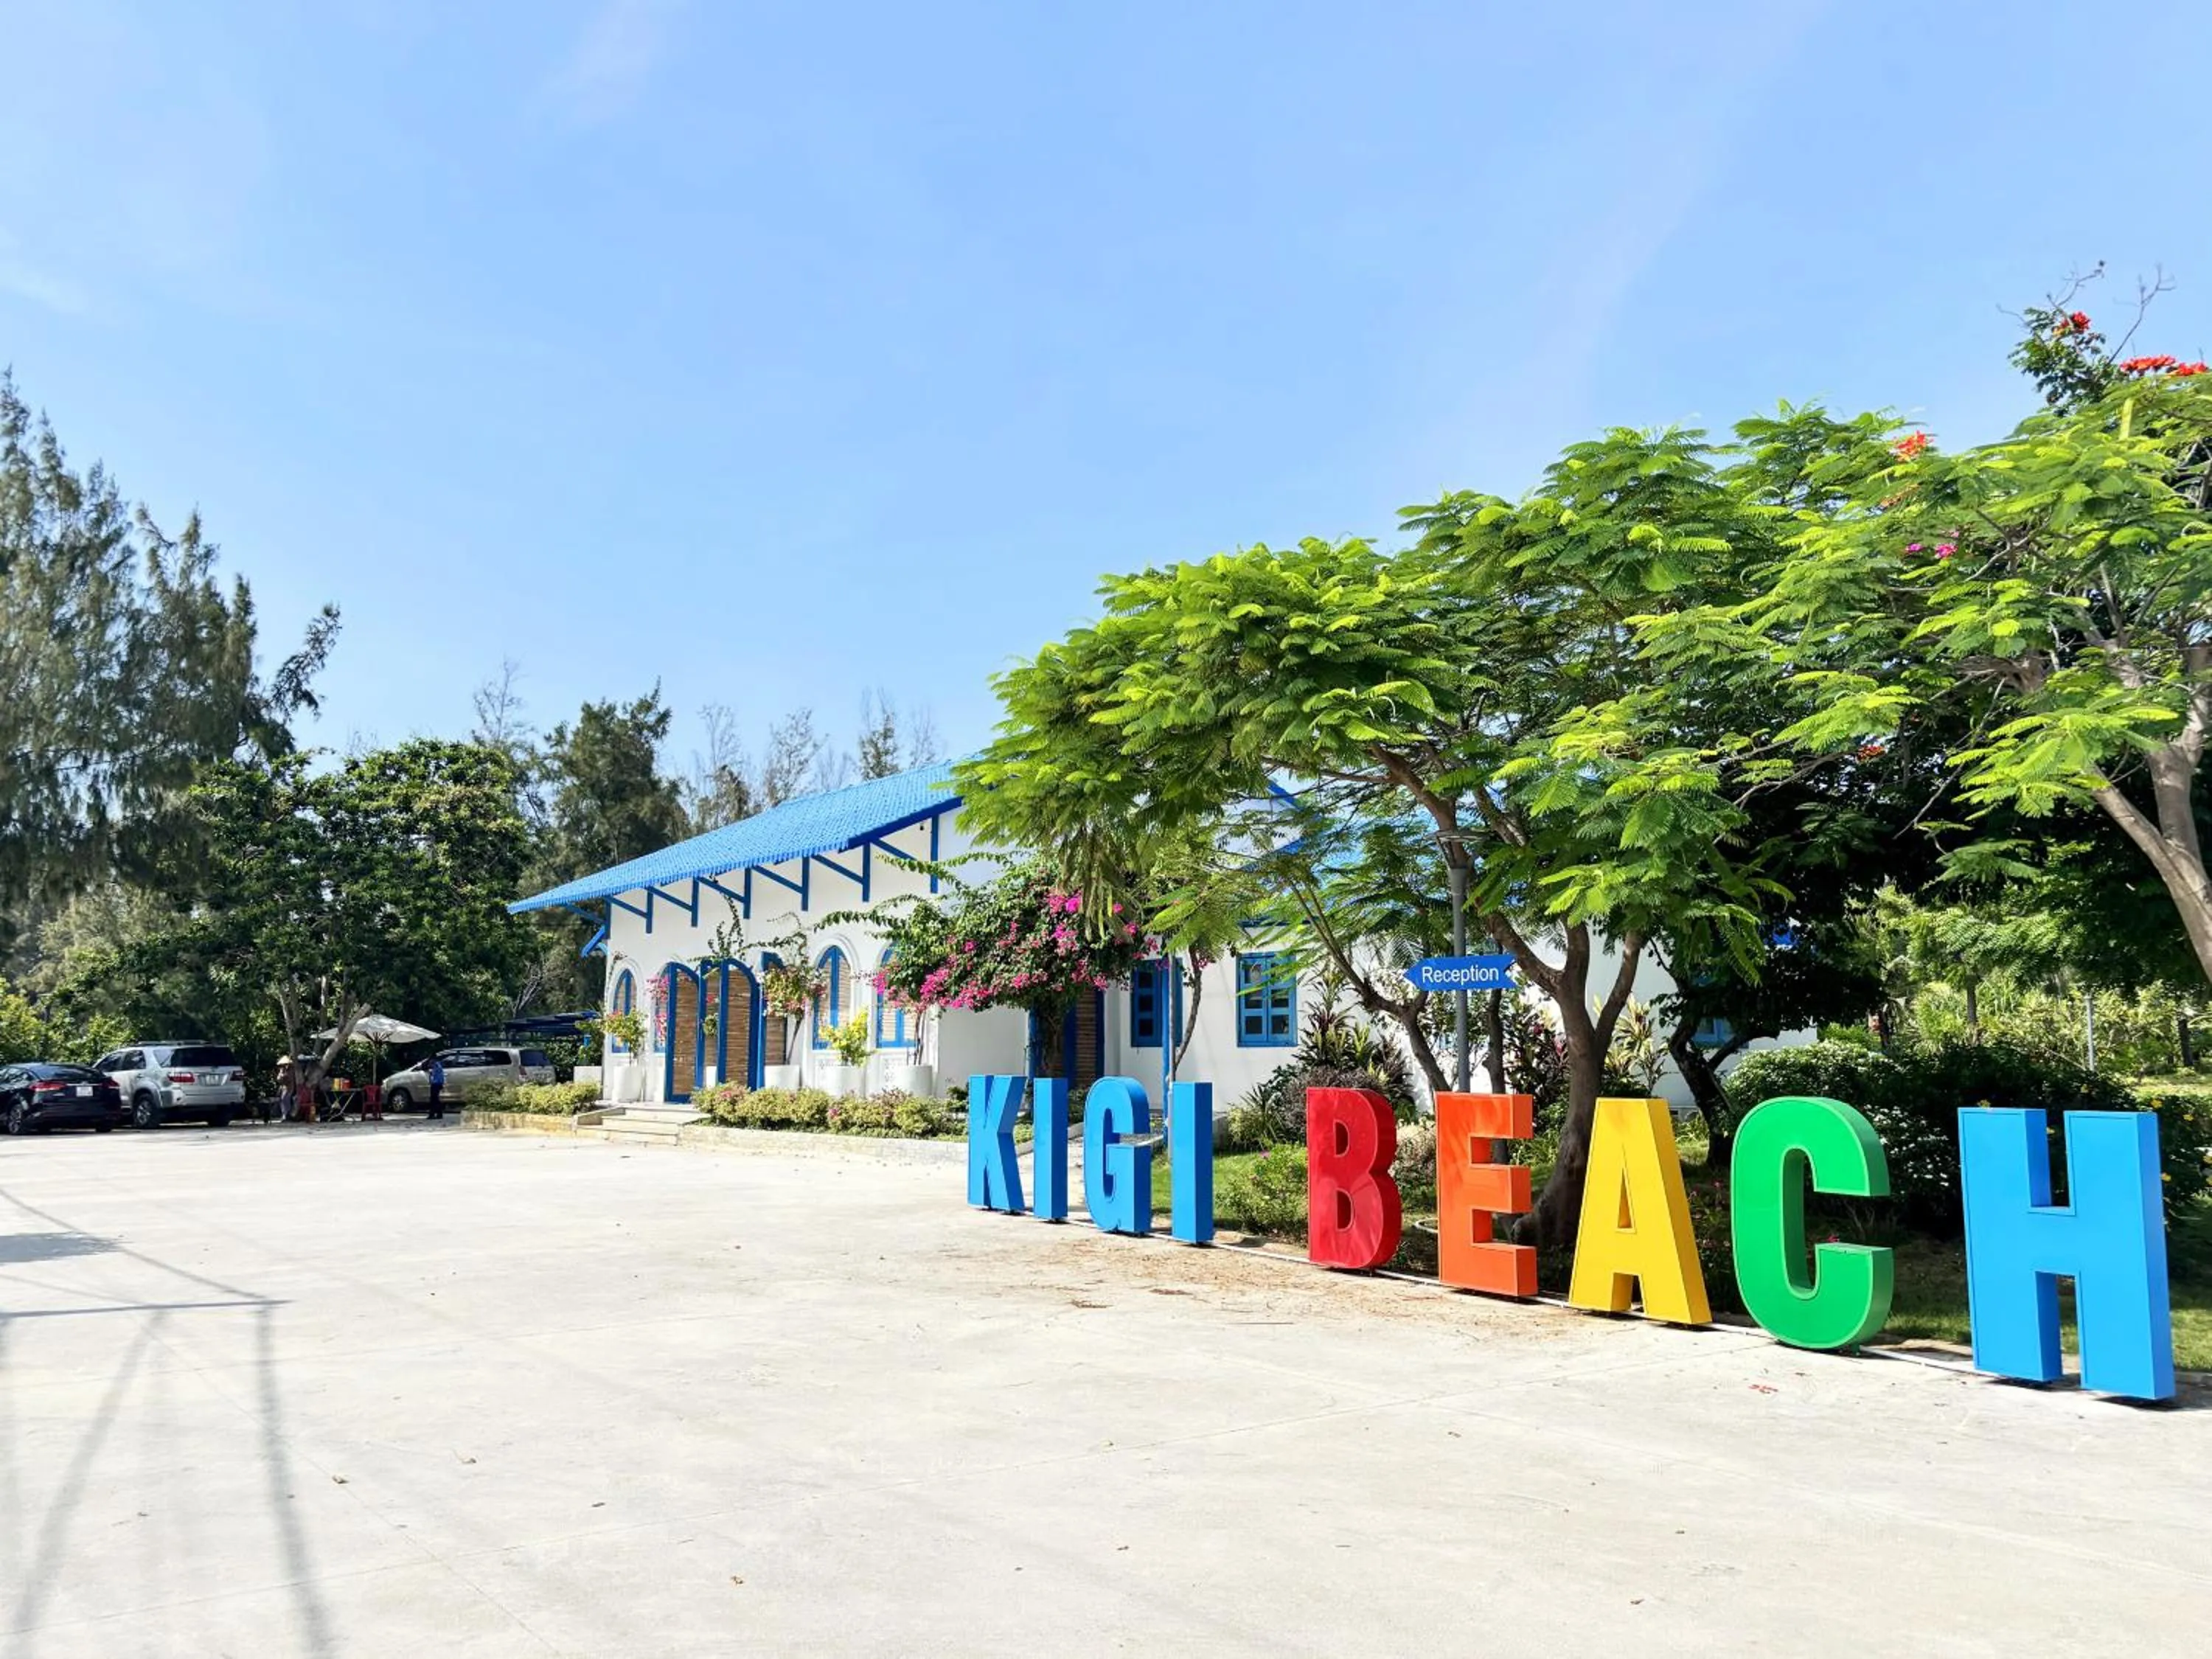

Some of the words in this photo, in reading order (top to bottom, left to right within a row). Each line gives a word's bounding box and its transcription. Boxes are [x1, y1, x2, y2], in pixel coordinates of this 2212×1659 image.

[1422, 964, 1499, 985] Reception
[968, 1074, 1215, 1245] KIGI
[1306, 1087, 2177, 1400] BEACH
